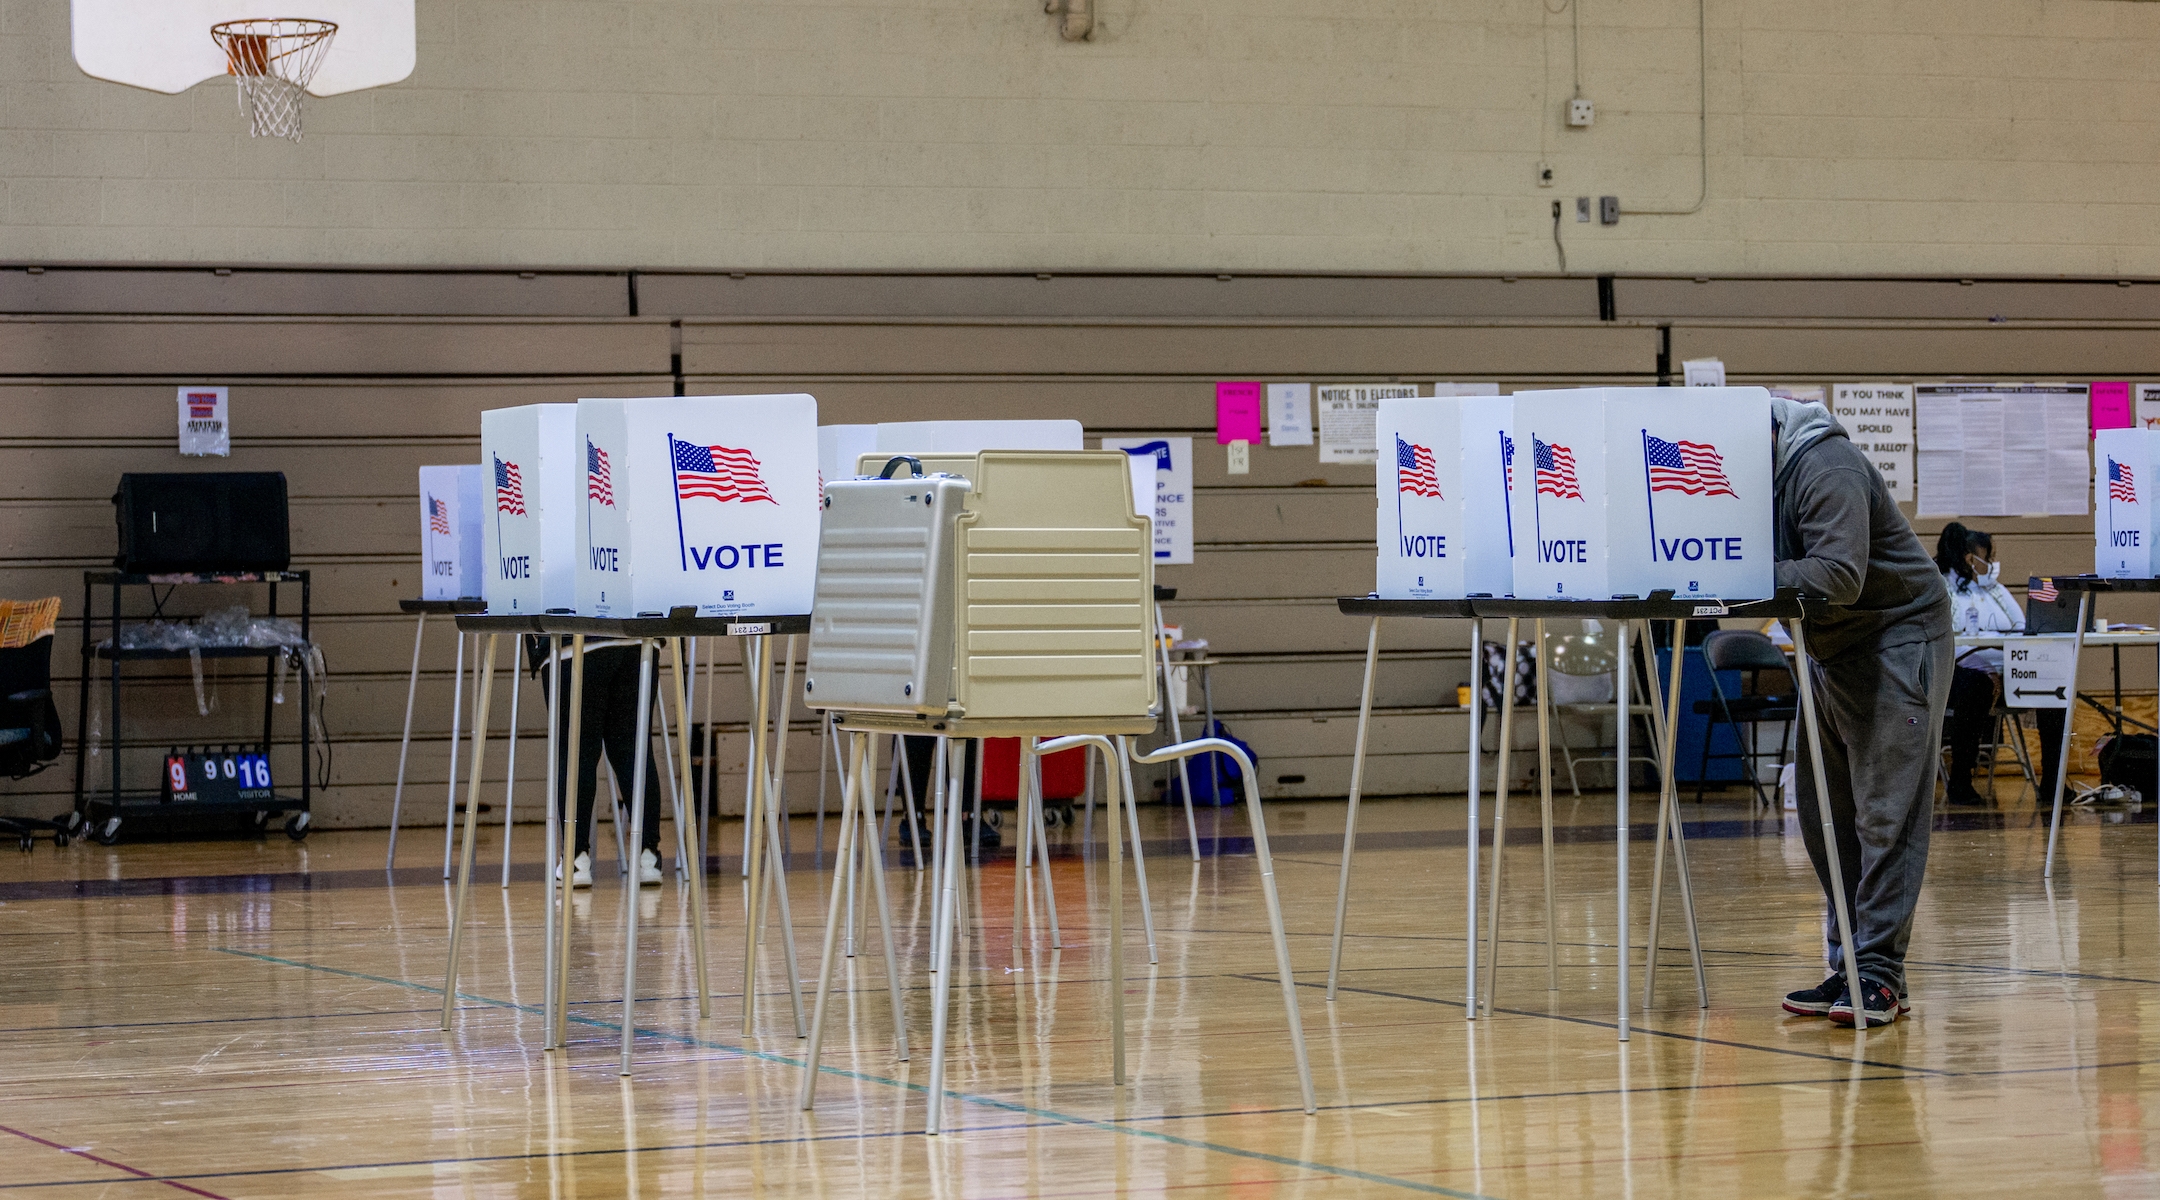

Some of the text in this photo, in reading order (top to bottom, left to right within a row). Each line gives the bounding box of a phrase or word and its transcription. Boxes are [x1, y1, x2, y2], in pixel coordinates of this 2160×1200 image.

[1321, 388, 1415, 401] NOTICE TO ELECTORS
[1840, 390, 1904, 399] IF YOU THINK
[1835, 407, 1910, 417] YOU MAY HAVE
[1857, 424, 1892, 433] SPOILED
[1873, 443, 1908, 452] BALLOT
[1879, 462, 1896, 471] FOR
[2113, 530, 2140, 547] VOTE
[1404, 535, 1446, 558] VOTE
[1542, 539, 1587, 563] VOTE
[1659, 537, 1743, 561] VOTE
[592, 546, 619, 572] VOTE
[689, 543, 784, 570] VOTE
[433, 561, 453, 576] VOTE
[502, 555, 530, 580] VOTE
[734, 625, 764, 634] PCT 231
[2011, 650, 2029, 661] PCT
[2011, 668, 2037, 679] Room
[205, 759, 236, 779] 9 0
[240, 760, 270, 787] 16
[171, 763, 186, 790] 9
[173, 792, 197, 801] HOME
[238, 790, 271, 799] VISITOR
